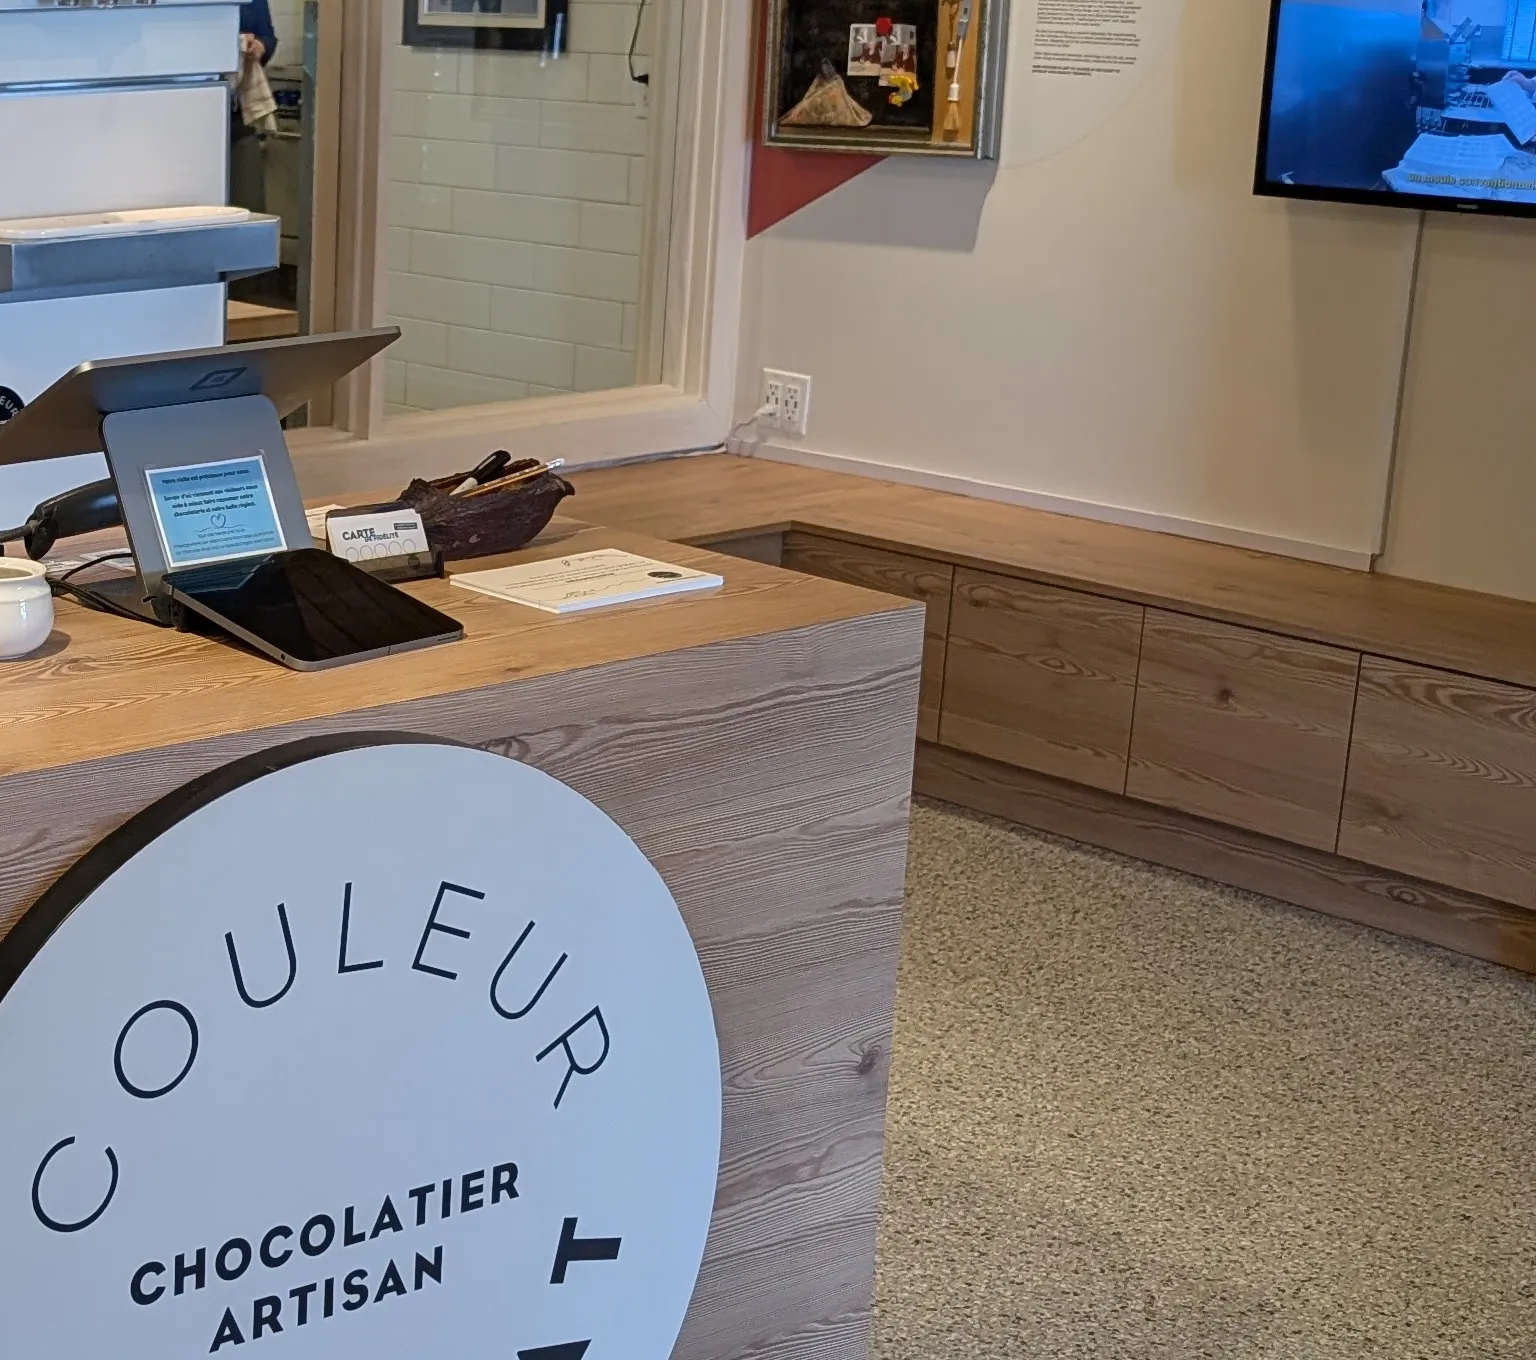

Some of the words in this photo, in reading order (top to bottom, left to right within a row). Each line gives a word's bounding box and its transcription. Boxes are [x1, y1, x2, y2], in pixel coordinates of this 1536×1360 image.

[342, 528, 375, 540] CARTE
[30, 879, 612, 1235] COULEUR
[128, 1160, 523, 1307] CHOCOLATIER
[207, 1245, 447, 1354] ARTISAN
